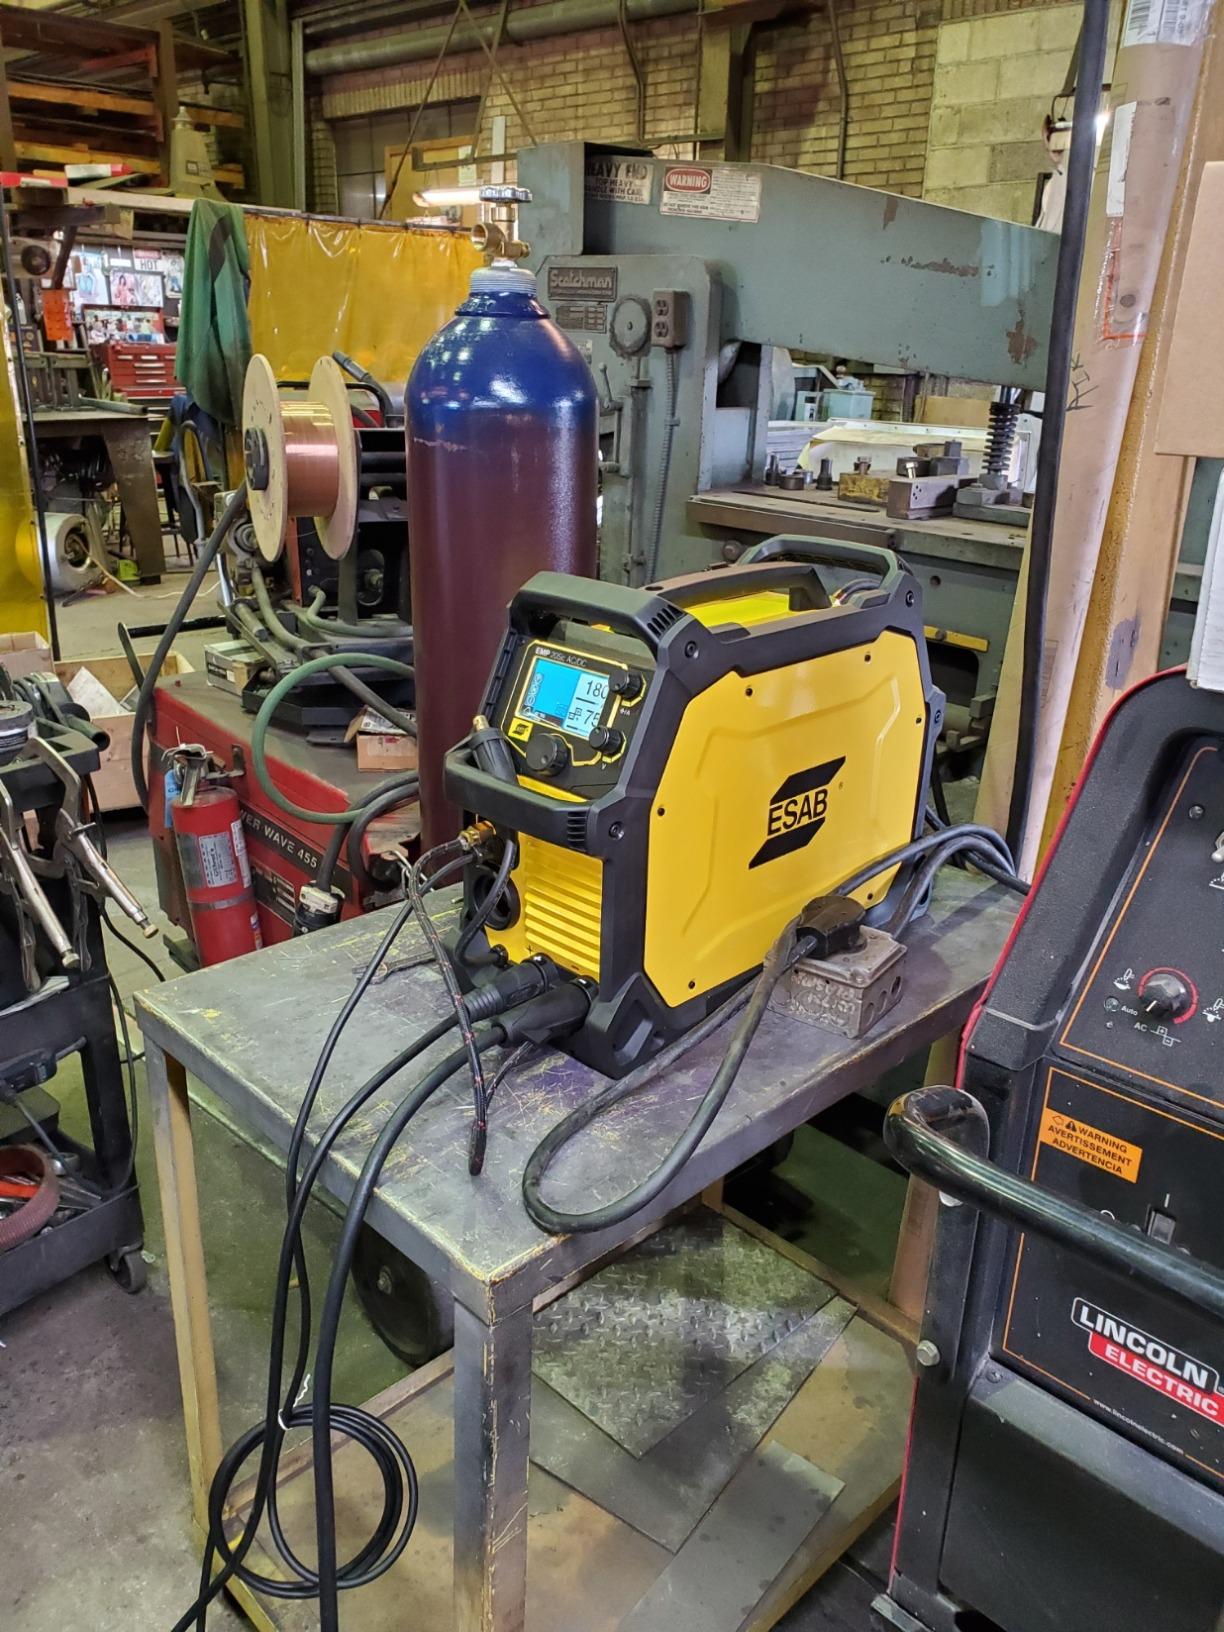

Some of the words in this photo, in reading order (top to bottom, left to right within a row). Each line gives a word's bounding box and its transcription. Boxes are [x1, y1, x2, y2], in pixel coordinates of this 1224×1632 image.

[670, 174, 708, 188] WARNING
[141, 260, 158, 271] HOT
[550, 270, 612, 288] Scotchman
[535, 647, 551, 657] EMP
[767, 788, 829, 836] ESAB
[264, 825, 296, 854] WAVE
[297, 849, 318, 868] 455
[1121, 1005, 1139, 1016] Auto
[1134, 1021, 1148, 1032] AC
[1048, 1124, 1133, 1167] AVERTISSEMENT
[1078, 1125, 1128, 1154] WARNING
[1052, 1137, 1123, 1174] ADVERTENCIA
[1079, 1306, 1209, 1389] LINCOLN
[1104, 1343, 1219, 1416] ELECTRIC
